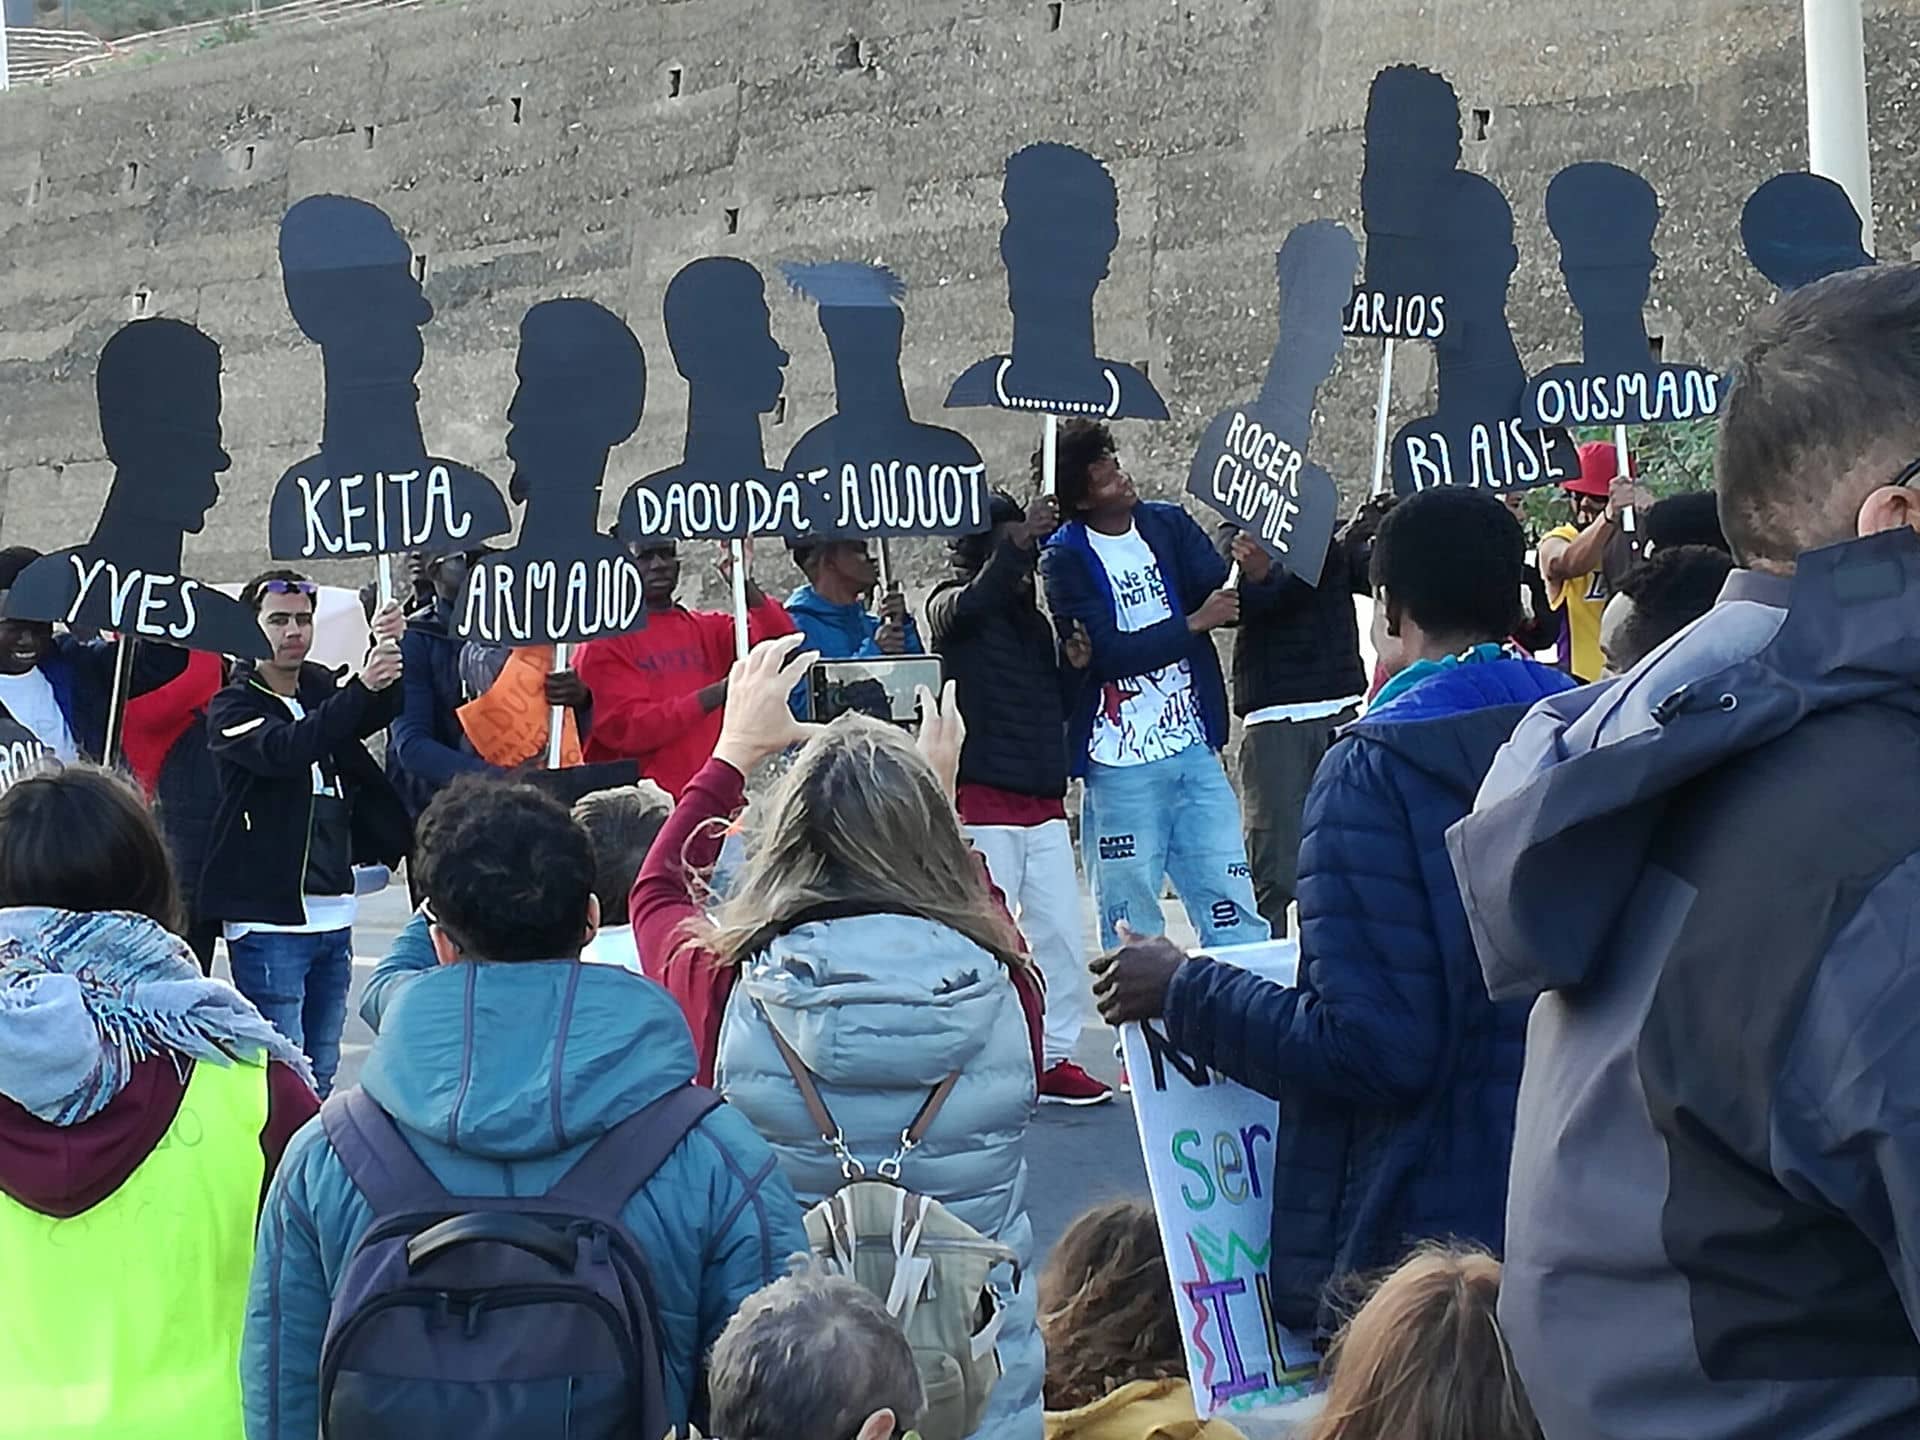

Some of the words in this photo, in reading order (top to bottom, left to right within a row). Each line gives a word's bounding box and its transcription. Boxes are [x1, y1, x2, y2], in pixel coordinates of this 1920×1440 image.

[1342, 291, 1445, 338] ARIOS
[1536, 370, 1718, 425] OUSMAN
[799, 461, 984, 530] ANNOT
[1225, 411, 1303, 498] ROGER
[297, 465, 472, 557] KEITA
[636, 479, 810, 537] DAOUDA
[1212, 454, 1300, 553] CHIMIE
[67, 554, 199, 638] YVES
[458, 556, 643, 641] ARMAND
[1172, 1124, 1271, 1211] ser
[1186, 1273, 1319, 1399] IL
